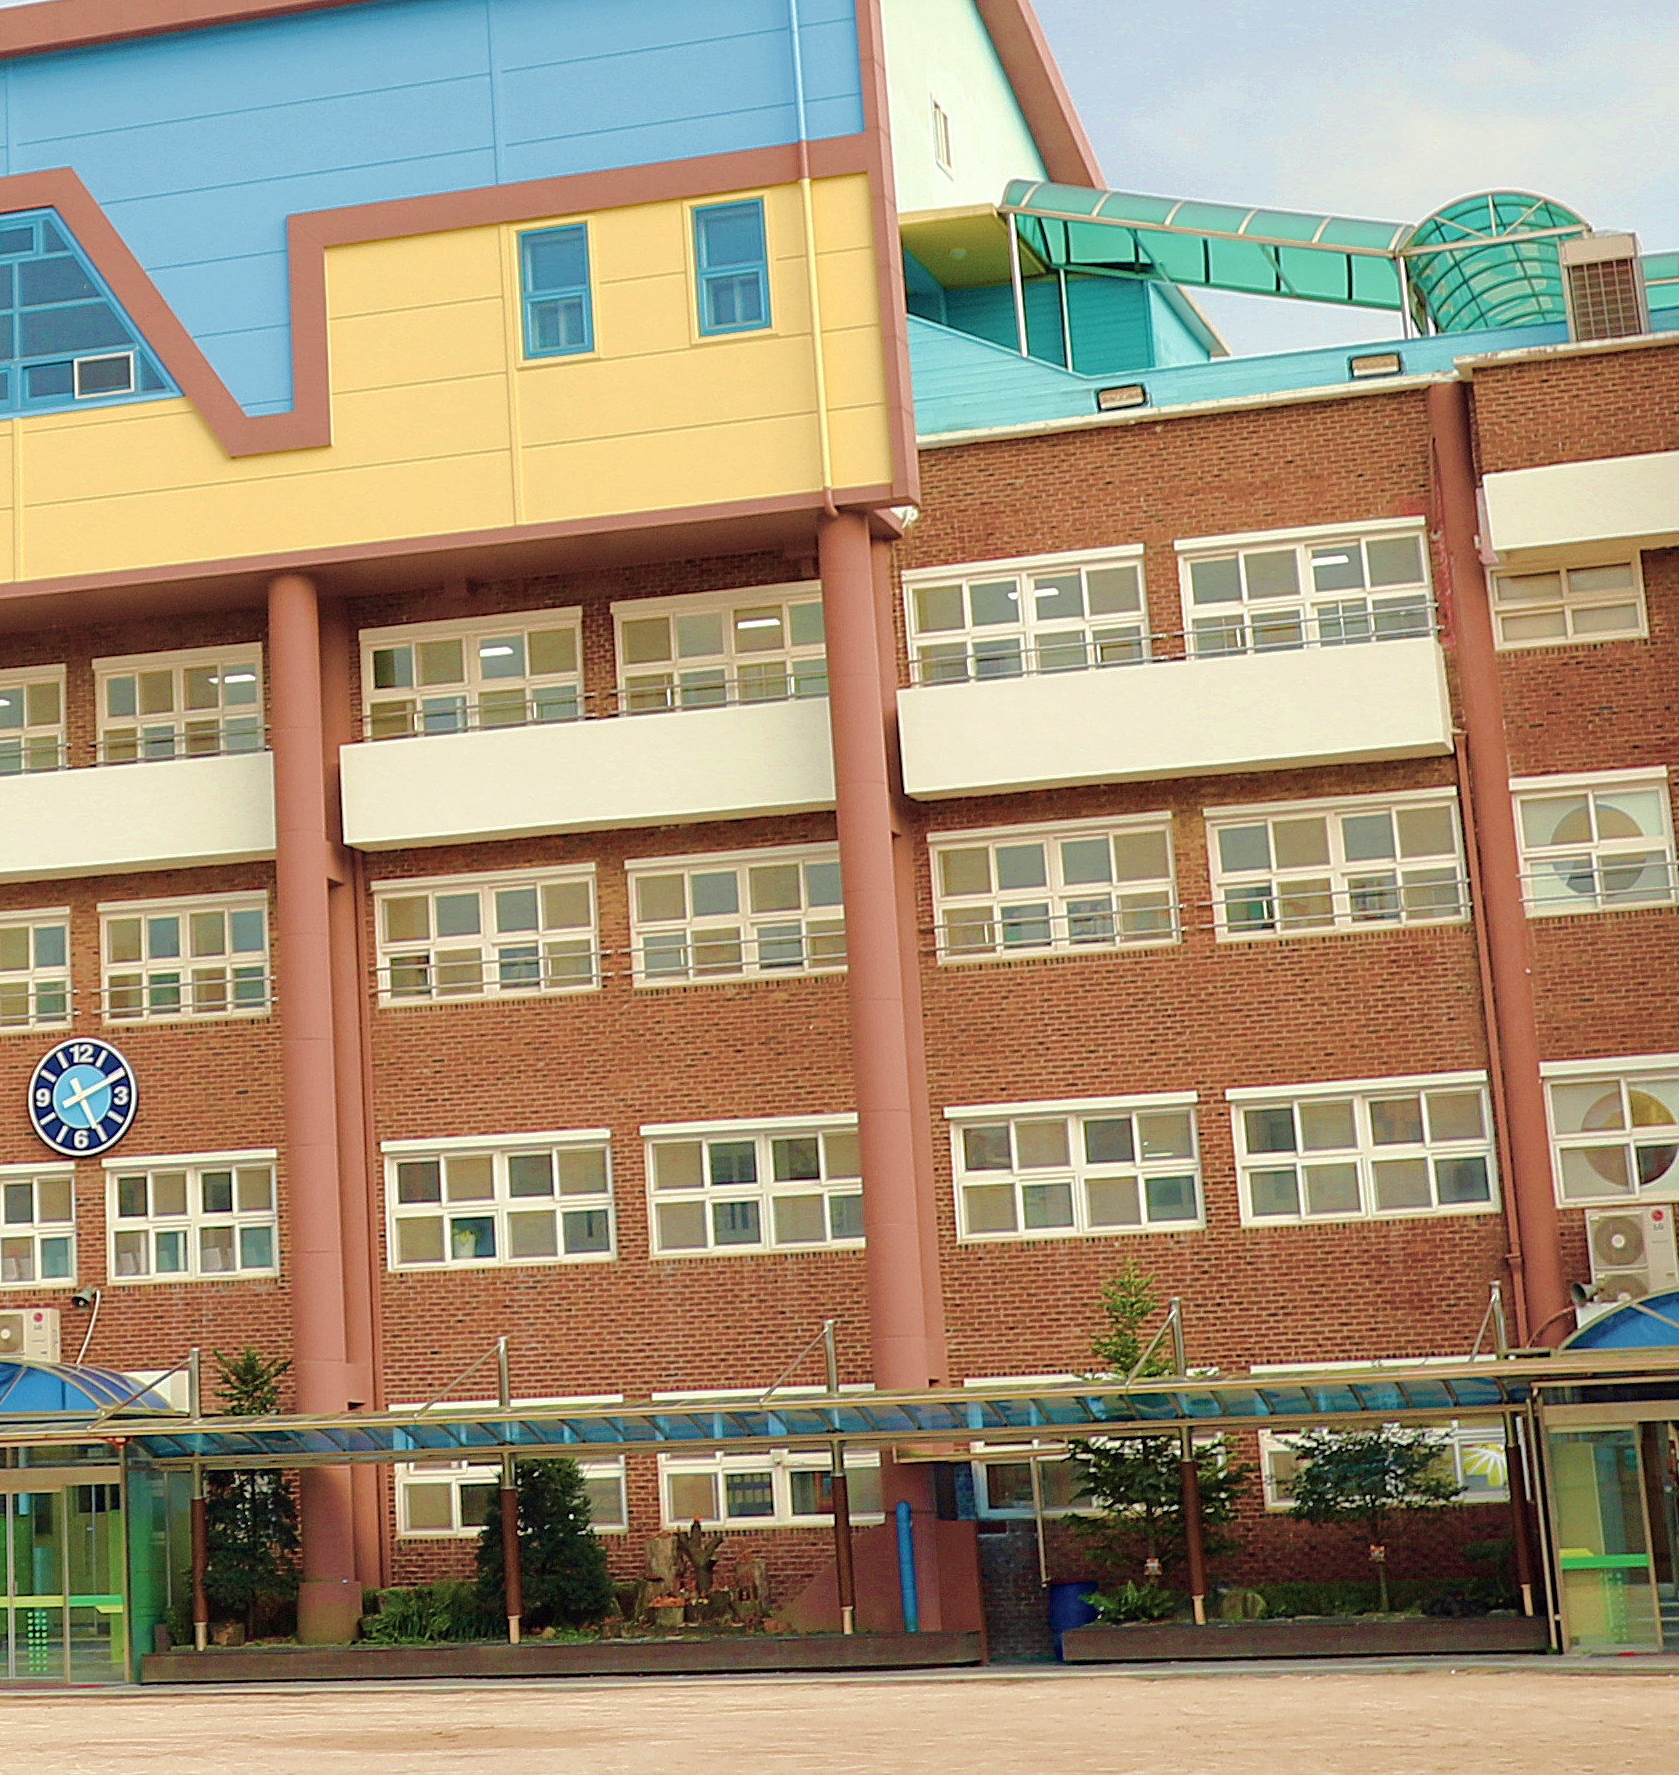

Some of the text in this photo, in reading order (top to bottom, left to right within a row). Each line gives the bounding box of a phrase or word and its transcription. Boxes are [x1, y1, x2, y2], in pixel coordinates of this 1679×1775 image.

[69, 1044, 94, 1064] 12
[35, 1088, 52, 1107] 9
[112, 1086, 130, 1106] 3
[72, 1129, 89, 1149] 6
